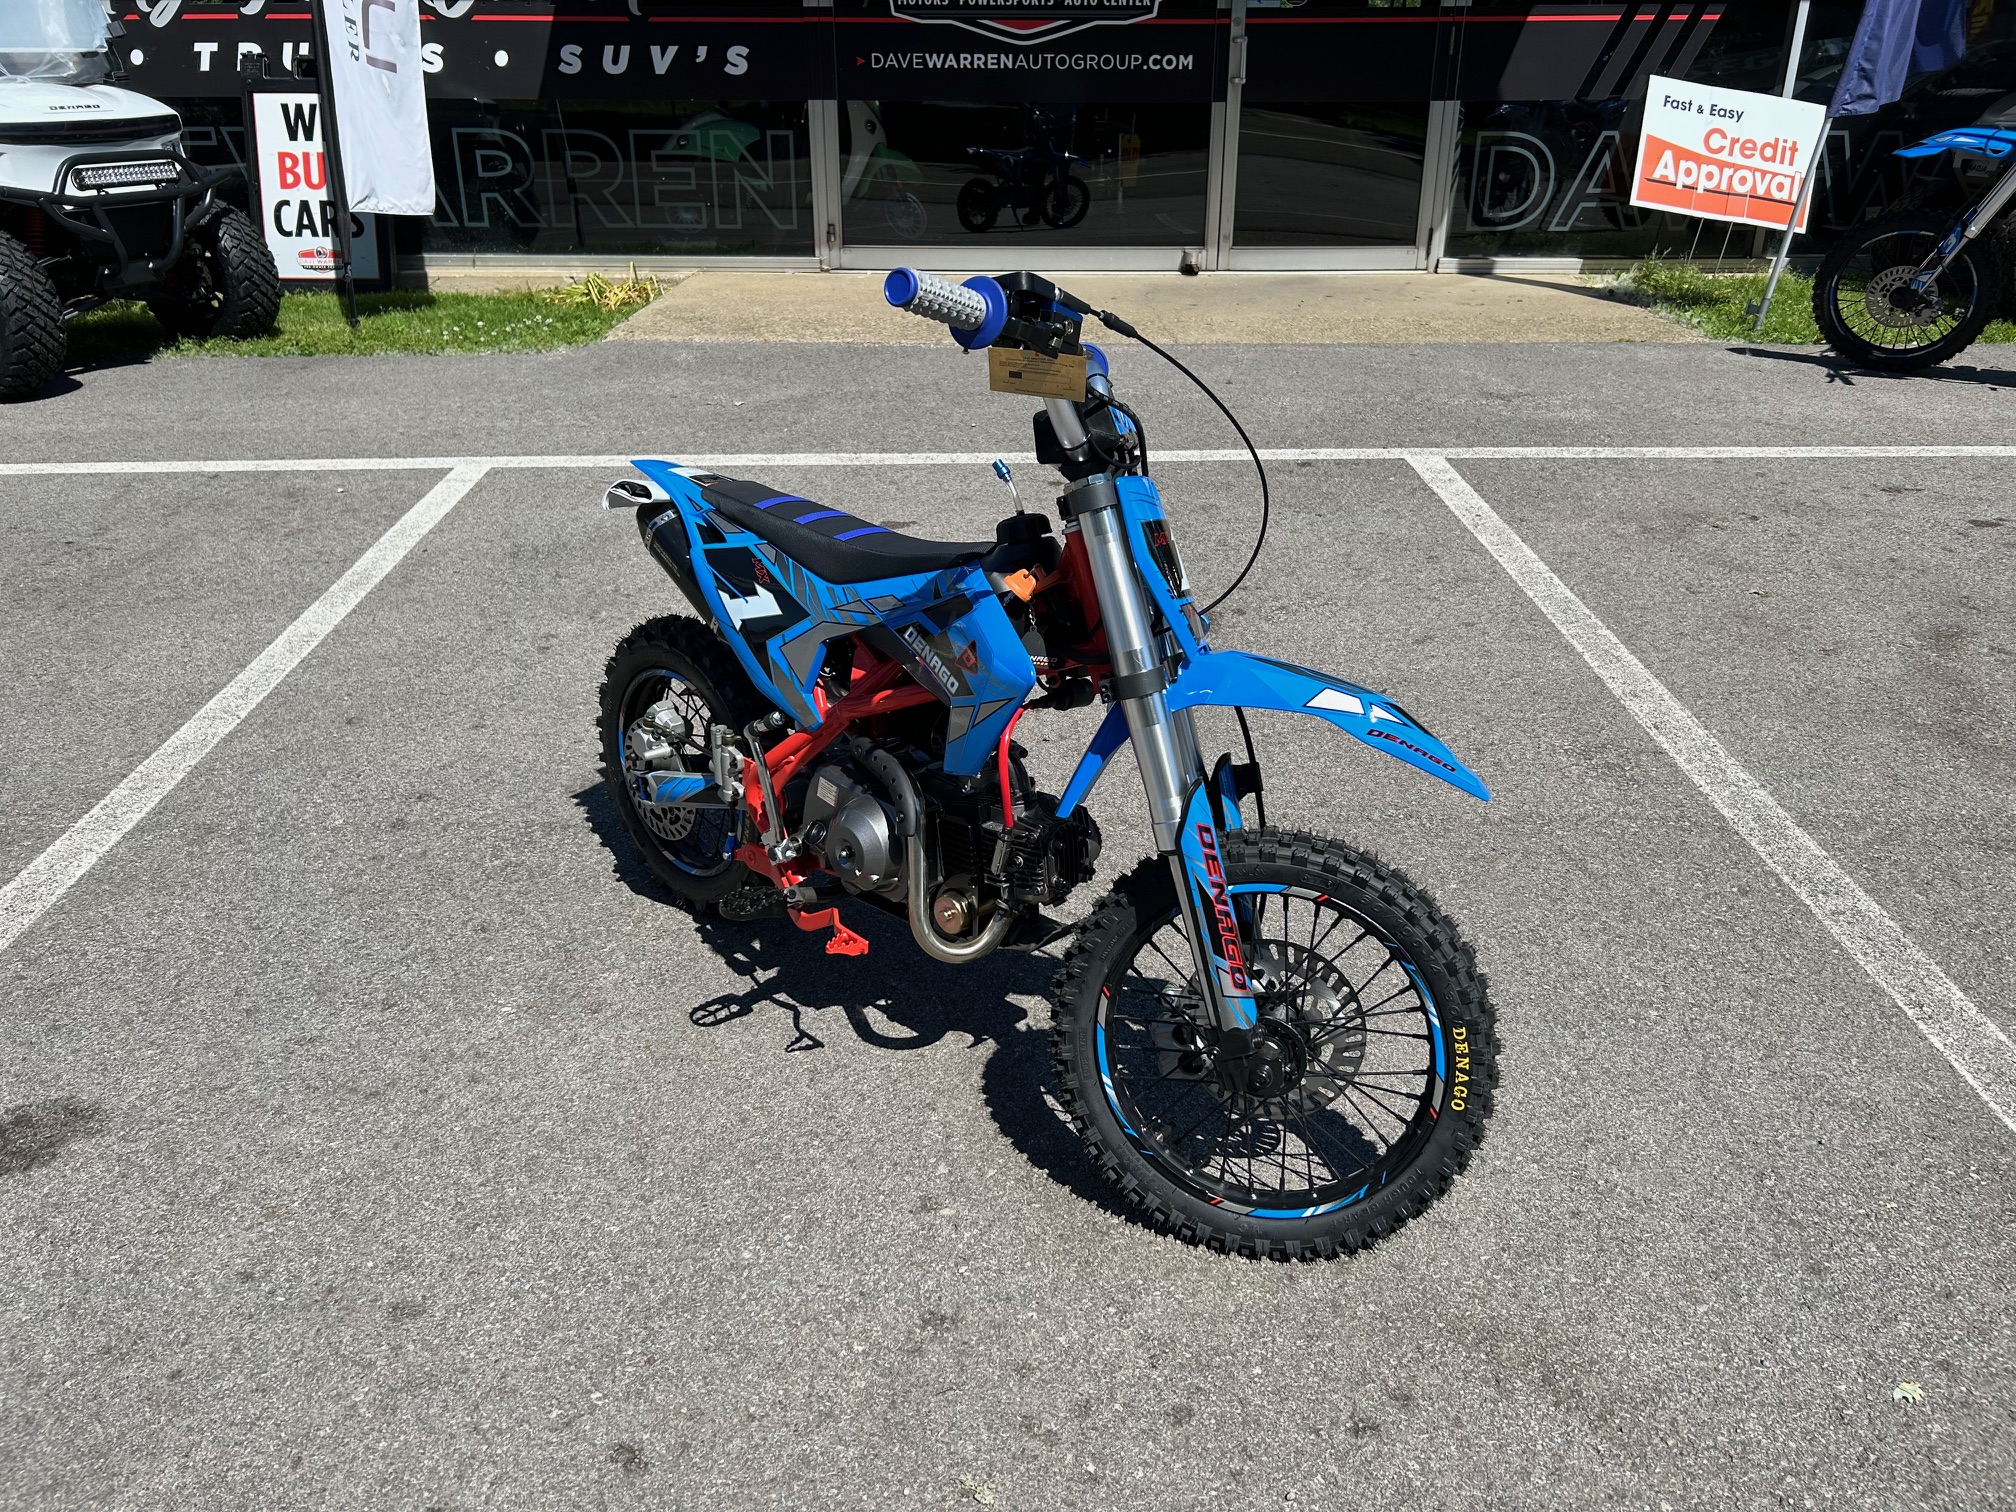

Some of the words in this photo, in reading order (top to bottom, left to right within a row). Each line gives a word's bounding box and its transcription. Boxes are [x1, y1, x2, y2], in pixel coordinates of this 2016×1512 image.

[871, 53, 1193, 70] DAVEWARRENAUTOGROUP.COM
[1663, 95, 1693, 112] Fast
[1696, 104, 1705, 115] &
[1709, 104, 1745, 123] Easy
[1703, 127, 1799, 167] Credit
[277, 151, 327, 190] BU
[1652, 149, 1803, 201] Approval
[751, 557, 771, 584] MX
[904, 625, 960, 695] DENAGO
[1365, 728, 1457, 773] DENAGO
[1195, 822, 1249, 992] DENAGO
[1450, 1026, 1469, 1112] DENAGO
